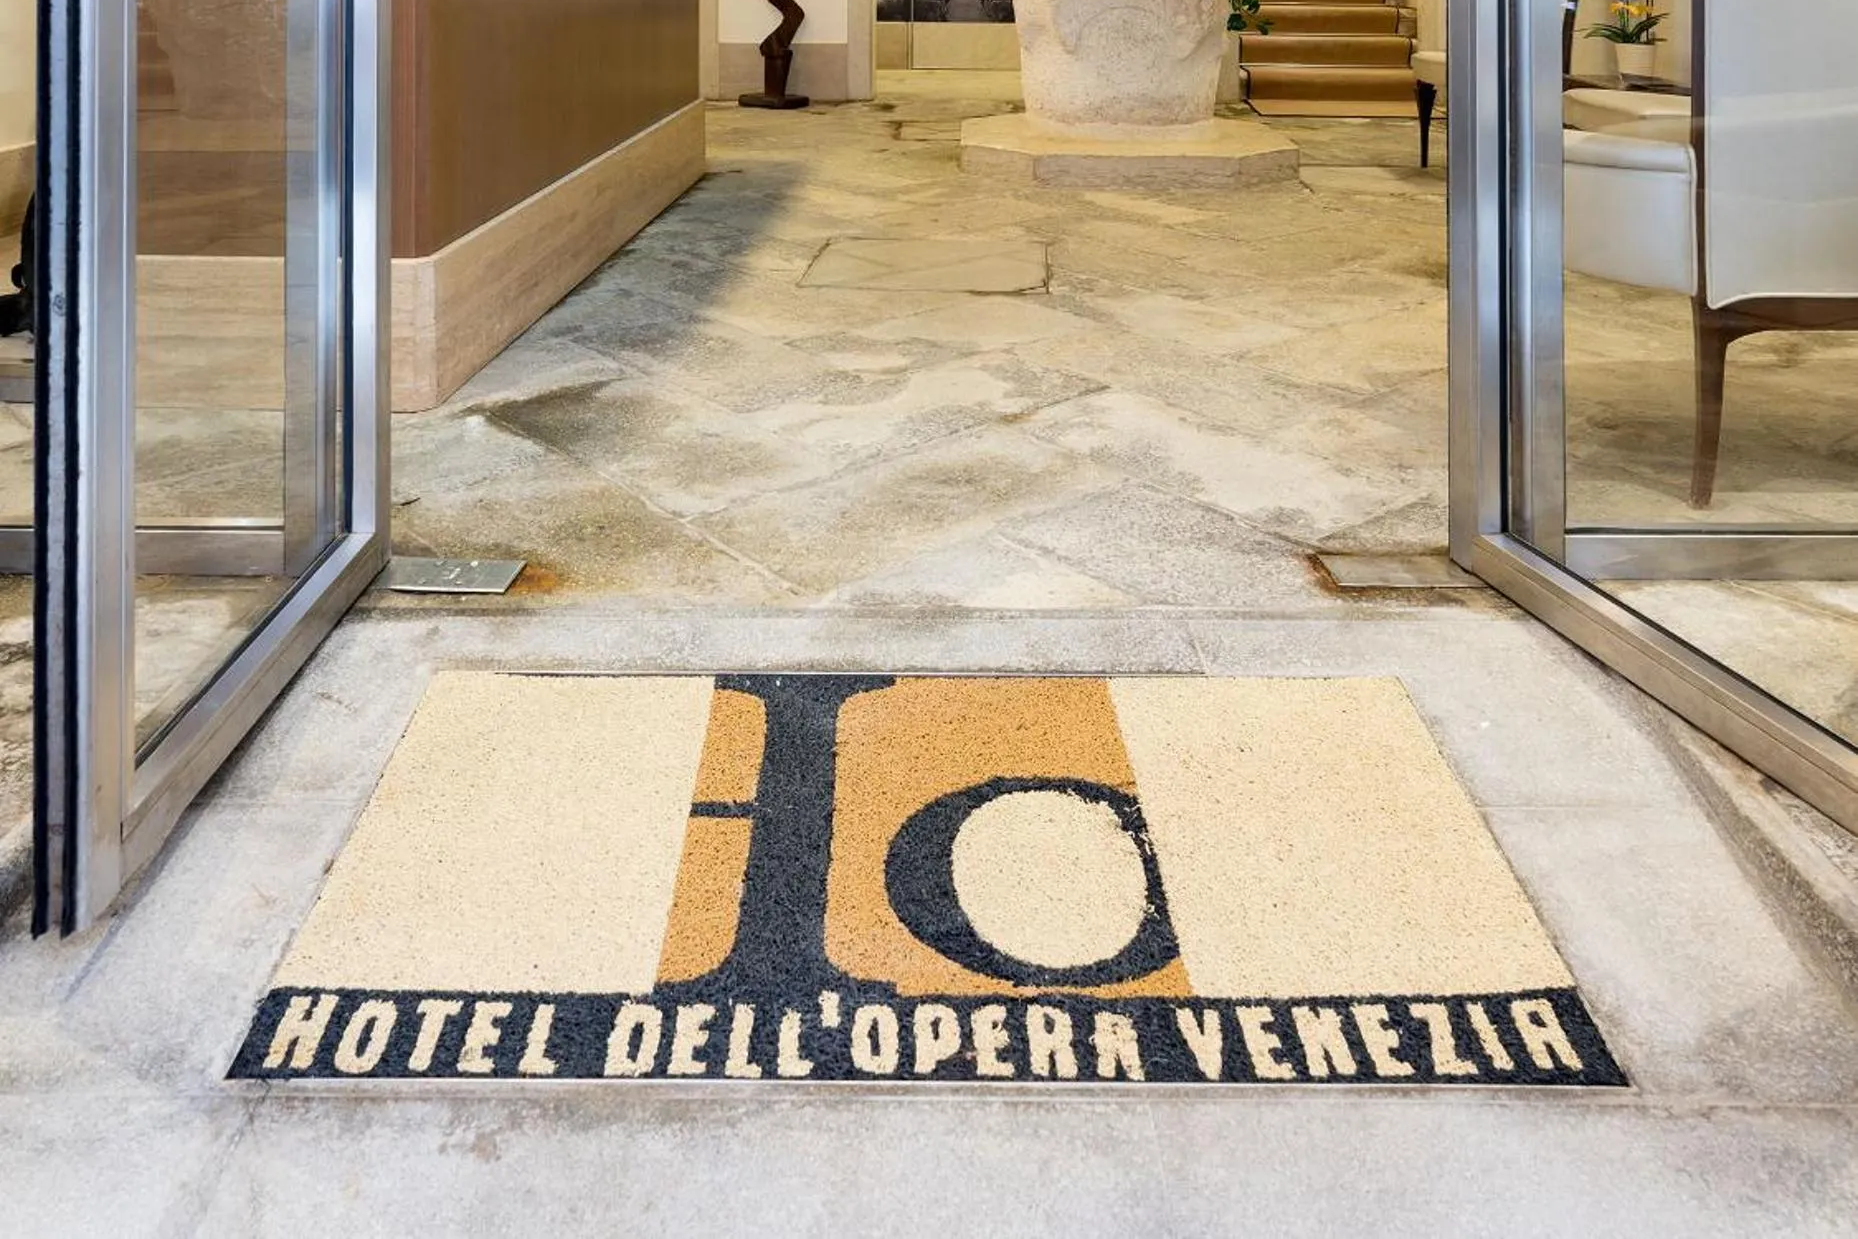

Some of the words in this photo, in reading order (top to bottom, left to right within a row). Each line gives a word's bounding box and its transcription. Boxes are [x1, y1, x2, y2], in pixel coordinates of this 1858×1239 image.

[262, 994, 557, 1075] HOTEL
[603, 992, 1145, 1078] DELL'OPERA
[1175, 997, 1585, 1077] VENEZIA
